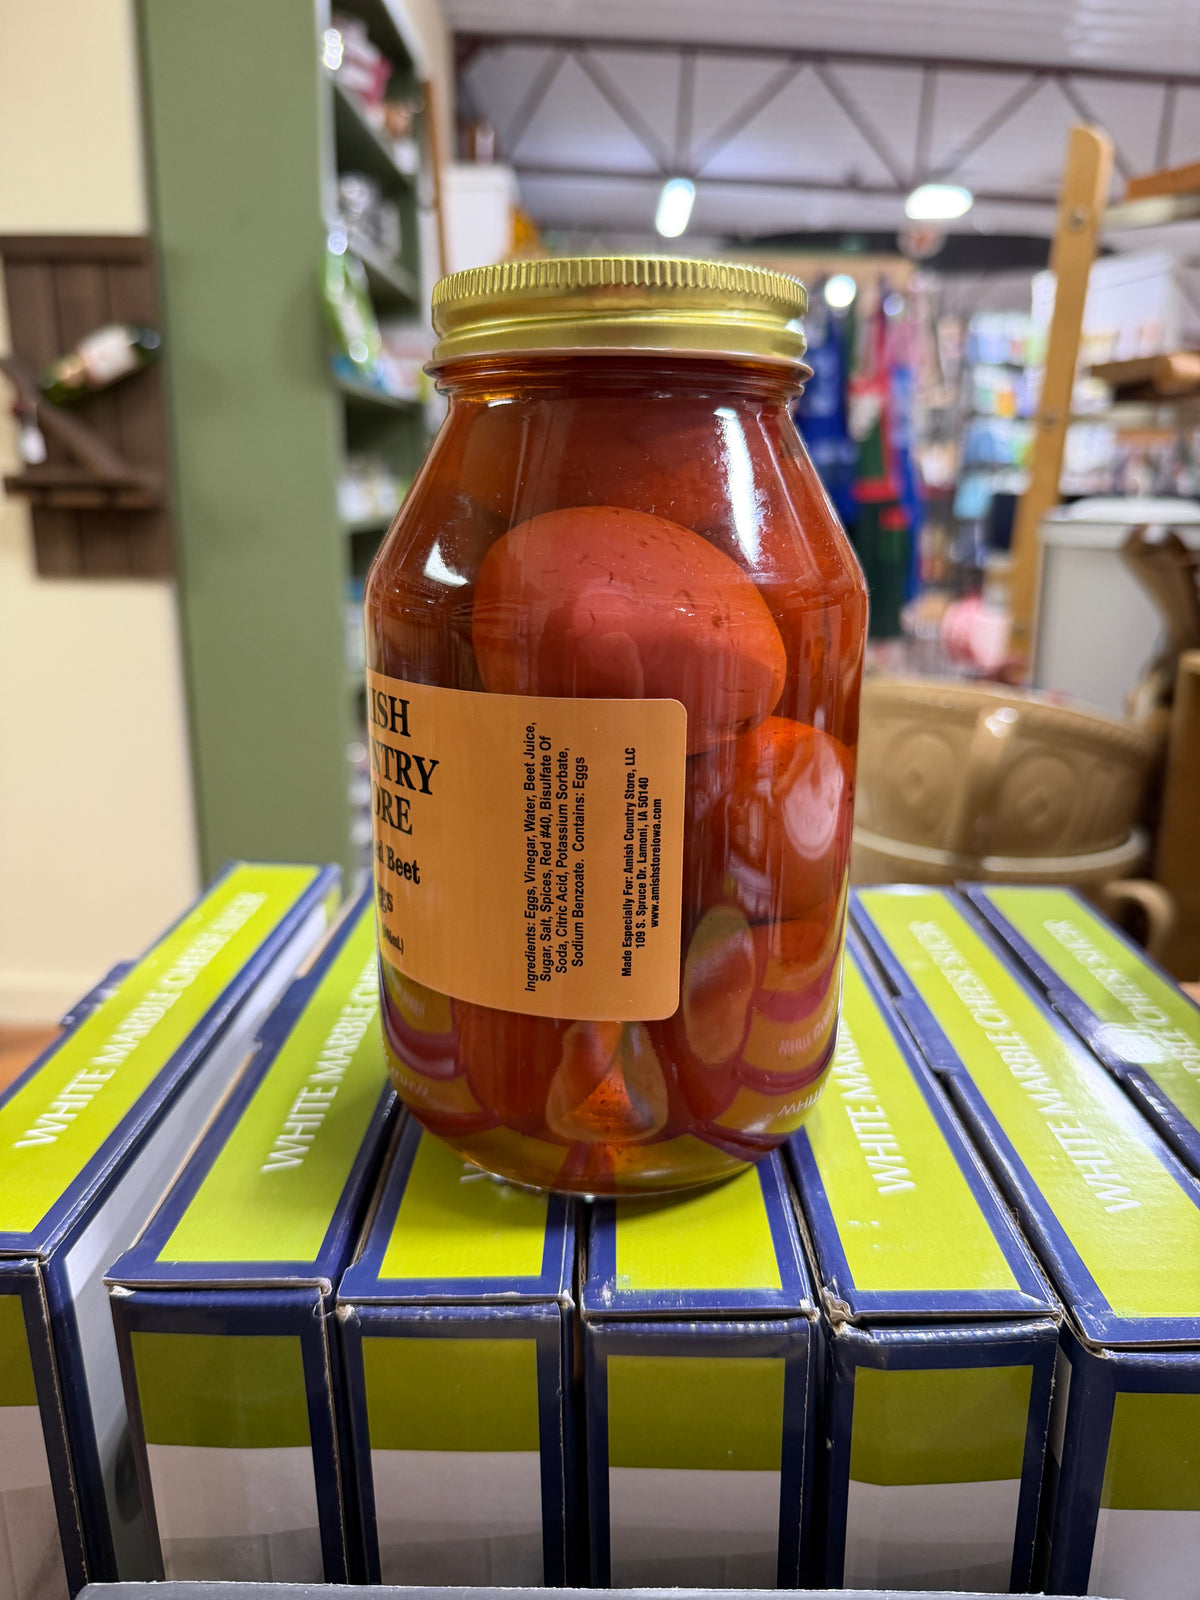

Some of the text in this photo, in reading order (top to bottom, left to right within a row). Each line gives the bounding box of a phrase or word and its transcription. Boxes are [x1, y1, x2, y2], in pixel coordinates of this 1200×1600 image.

[386, 844, 420, 885] Beet
[524, 722, 538, 992] Ingredients: Eggs, Vinegar, Water, Beet Juice,
[539, 735, 554, 982] Sugar, Salt, Spices, Red #40, Bisulfate Of
[555, 748, 570, 973] Soda, Citric Acid, Potassium Sorbate,
[571, 757, 588, 967] Sodium Benzoate. Contains: Eggs
[622, 748, 636, 976] Made Especially For: Amish Country Store, LLC
[635, 778, 649, 948] 109 S. Spruce Dr. Lamoni, IA 50140
[650, 799, 661, 927] www.amishstoreiowa.com
[12, 1067, 117, 1149] WHITE
[89, 988, 182, 1068] MARBLE
[260, 1003, 378, 1174] WHITE MARBLE
[845, 1104, 917, 1196] WHITE
[985, 1030, 1077, 1116] MARBLE
[1045, 1119, 1142, 1213] WHITE
